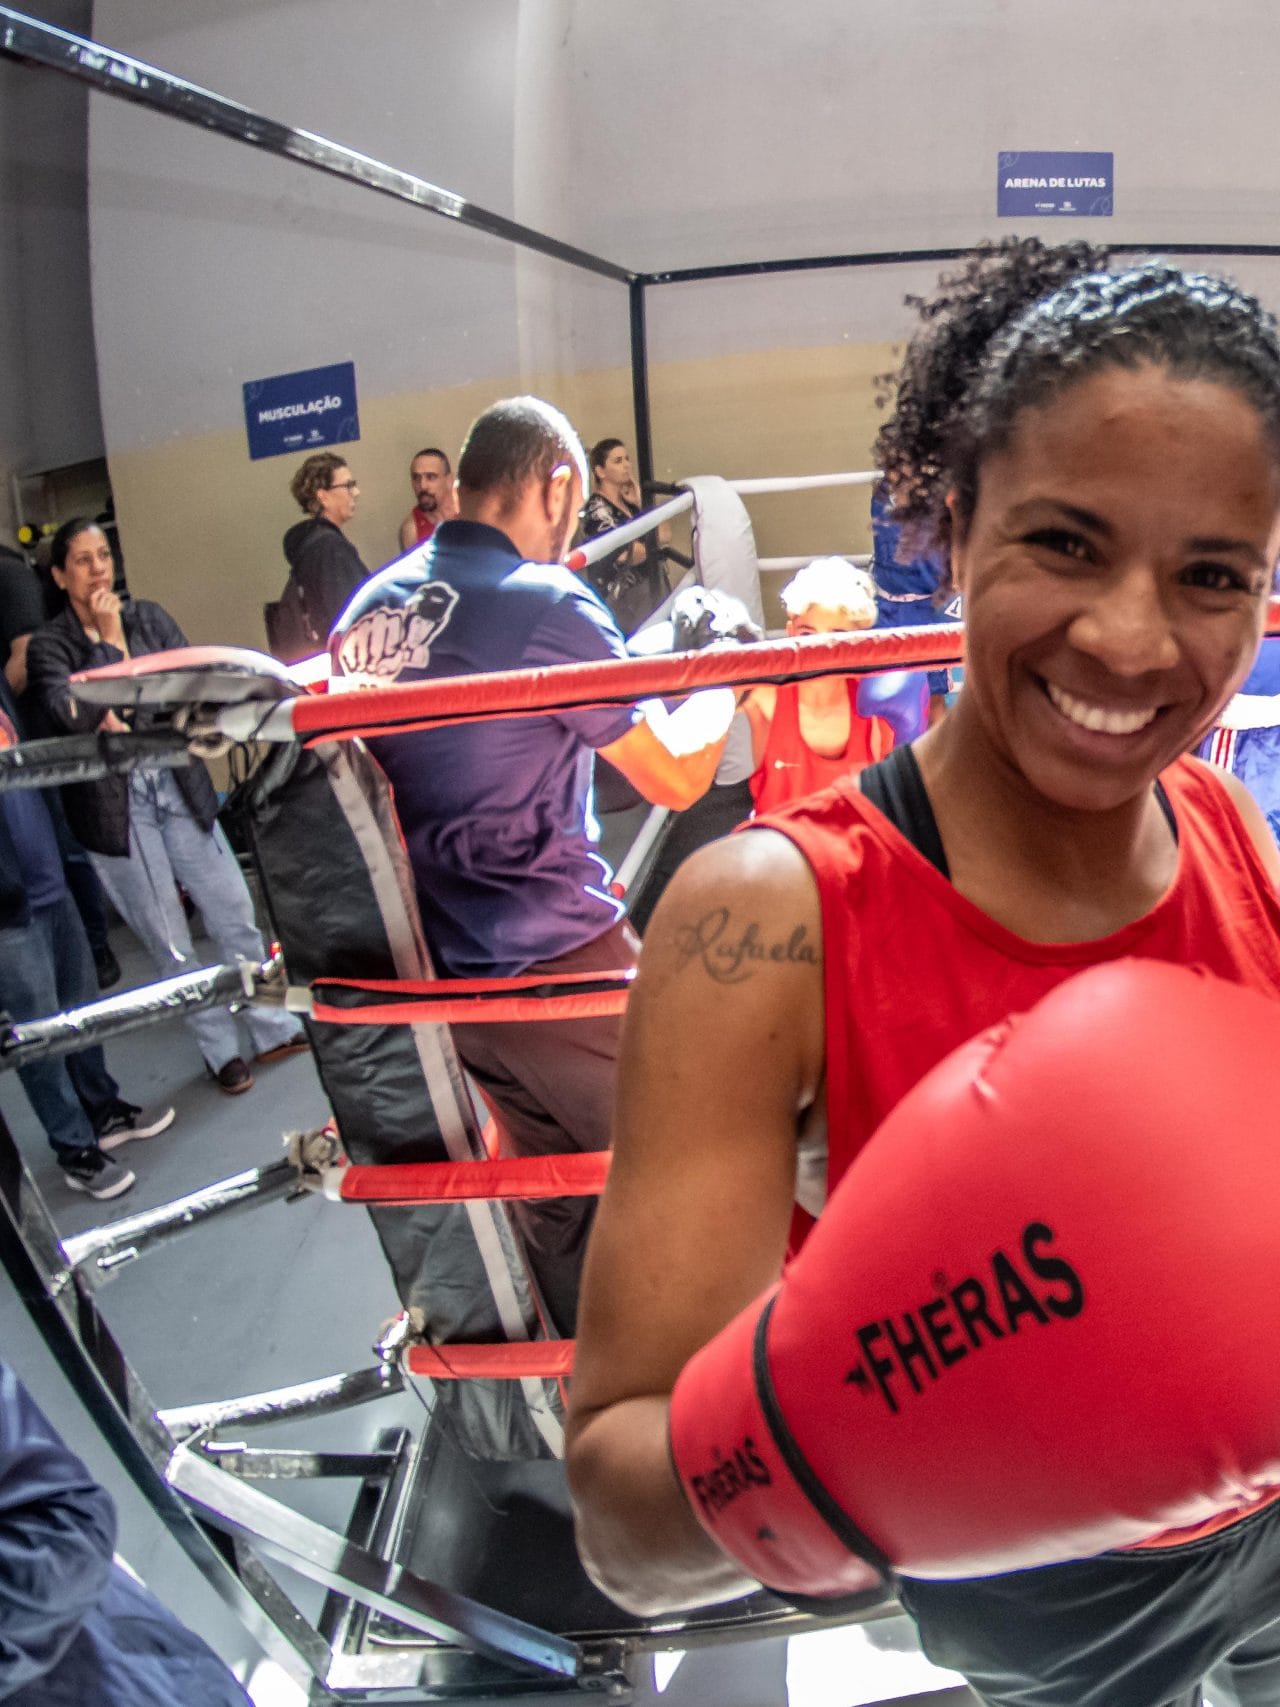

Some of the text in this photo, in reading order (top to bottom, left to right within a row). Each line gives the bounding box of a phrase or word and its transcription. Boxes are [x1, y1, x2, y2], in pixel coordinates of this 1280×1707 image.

[1004, 177, 1106, 189] ARENA DE LUTAS
[258, 394, 342, 423] MUSCULAÇÃO
[672, 906, 819, 984] Rafaela
[855, 1221, 1085, 1415] FHERAS
